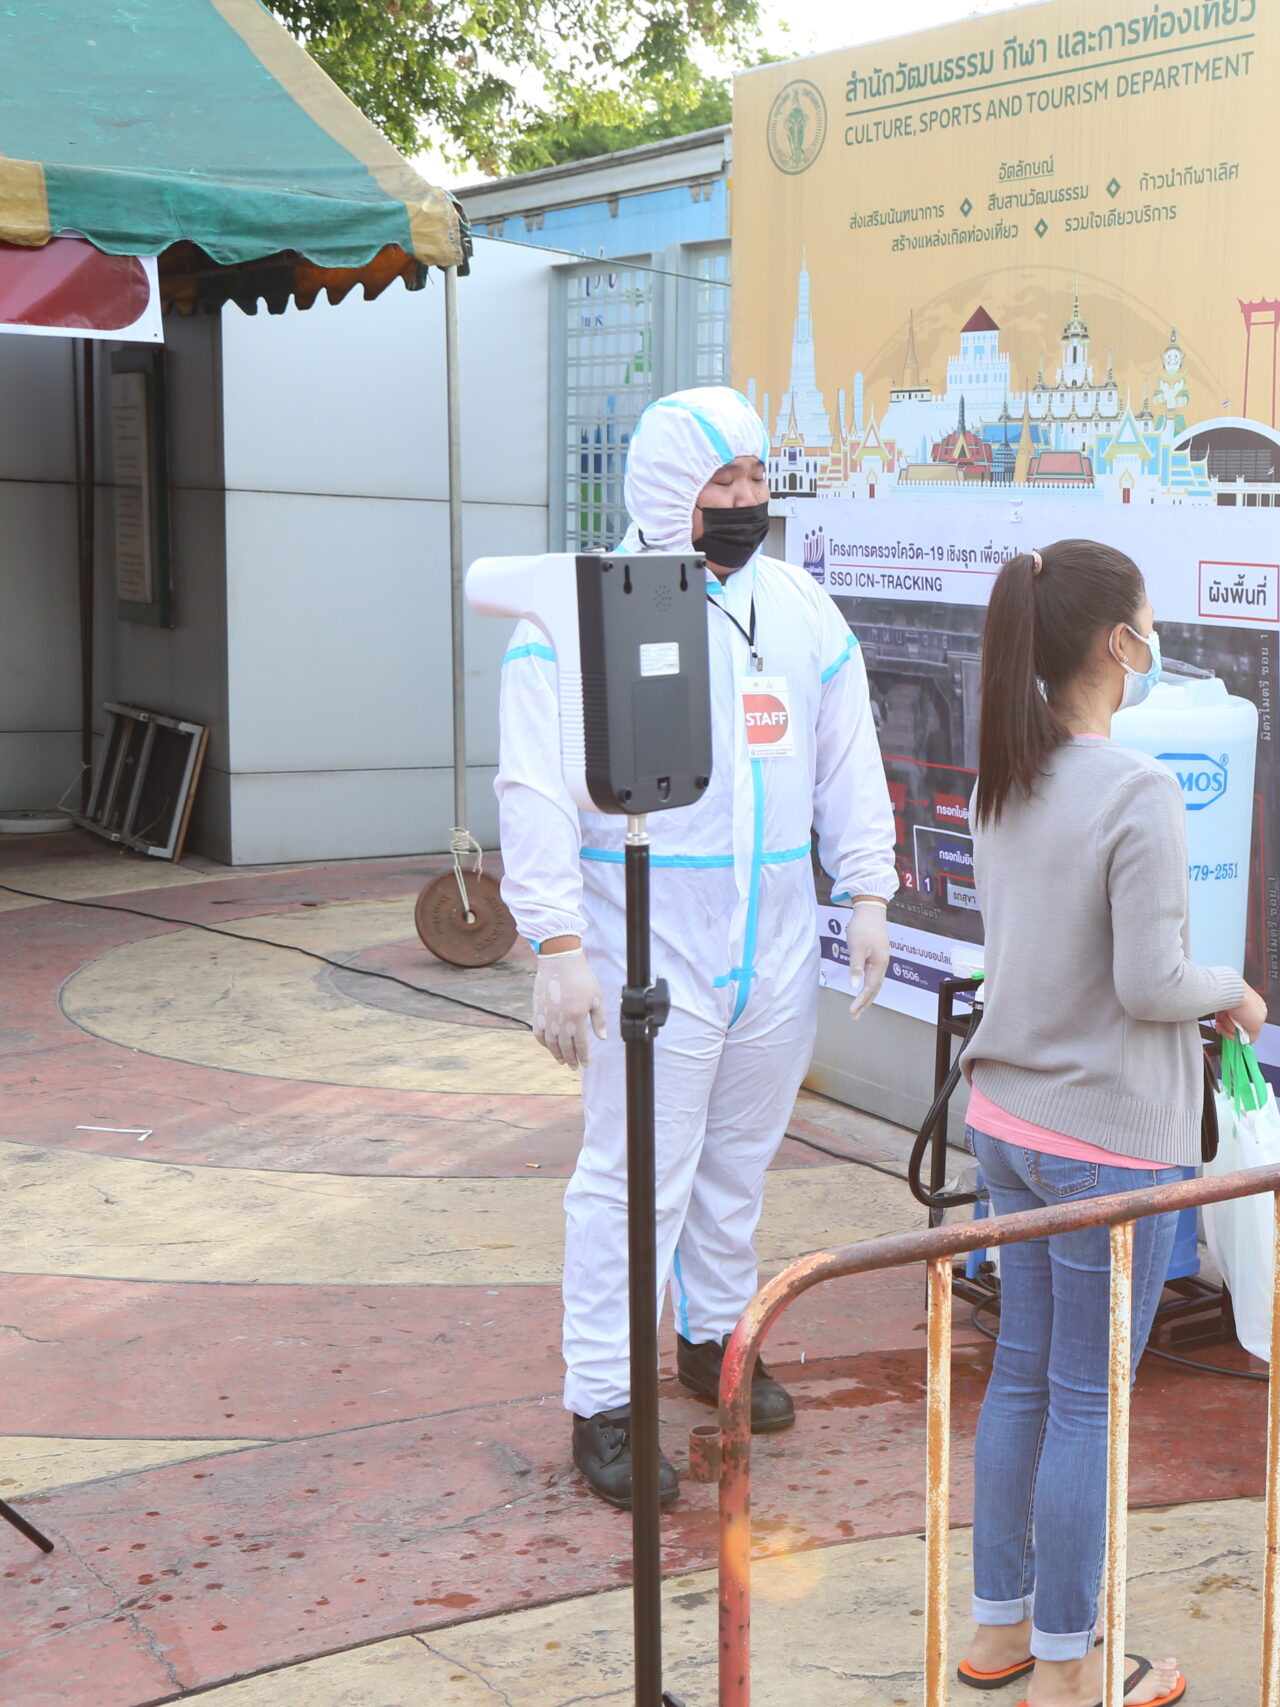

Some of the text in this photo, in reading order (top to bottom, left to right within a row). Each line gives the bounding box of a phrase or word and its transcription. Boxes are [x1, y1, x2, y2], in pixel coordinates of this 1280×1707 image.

[845, 0, 1256, 103] สำนักวัฒนธรรม กีฬา และการท่องเทยว
[845, 115, 916, 146] CULTURE,
[919, 102, 982, 133] SPORTS
[986, 94, 1022, 121] AND
[1027, 79, 1109, 113] TOURISM
[1116, 51, 1255, 98] DEPARTMENT
[849, 204, 945, 230] ส่งเสริมนันทนาการ
[988, 185, 1089, 211] สืบสานวัฒนธรรม
[1065, 205, 1177, 232] รวมใจเดียวบริการ
[829, 538, 944, 562] โครงการตรวจโควิด-19
[946, 544, 977, 569] เชิงรุก
[830, 572, 853, 587] SSO
[855, 573, 943, 592] ICN-TRACKING
[1208, 574, 1268, 606] ผังพื้นที่
[745, 712, 786, 726] STAFF
[905, 873, 913, 887] 2
[924, 877, 931, 892] 1
